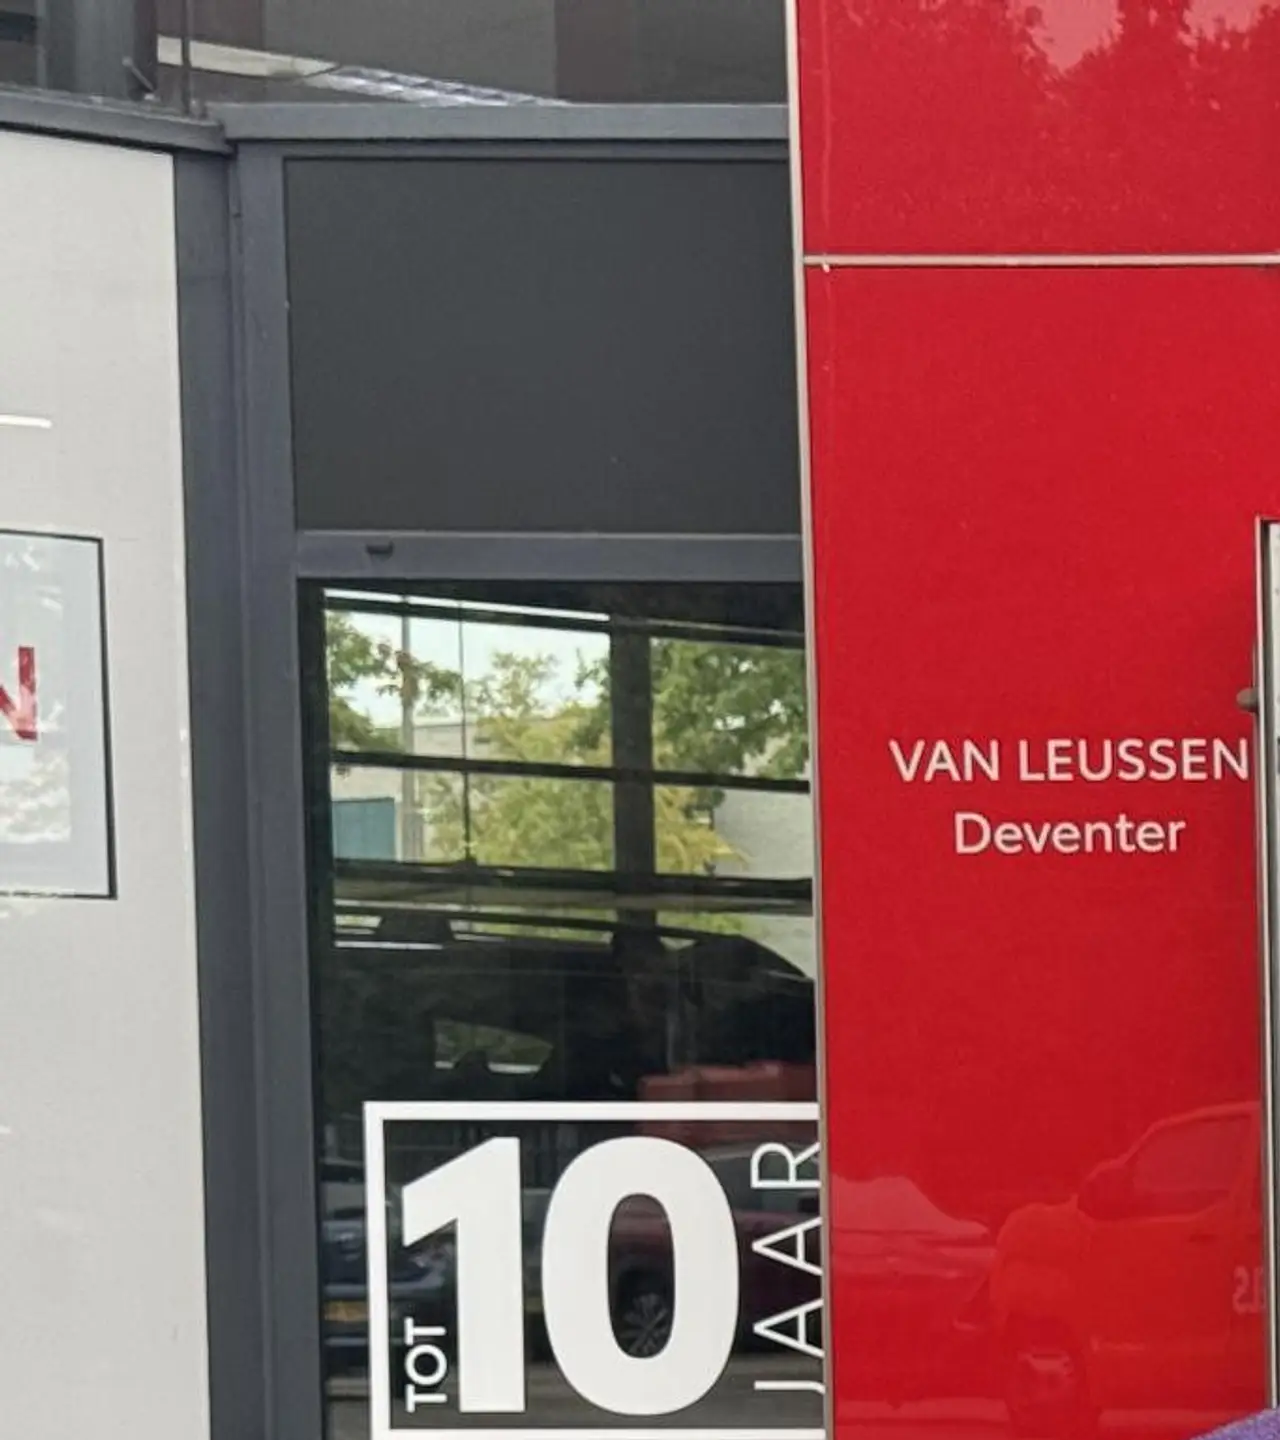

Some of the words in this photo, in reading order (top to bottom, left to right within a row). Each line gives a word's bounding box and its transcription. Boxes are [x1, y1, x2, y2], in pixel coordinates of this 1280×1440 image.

[889, 739, 999, 781] VAN
[1019, 738, 1249, 781] LEUSSEN
[954, 812, 1186, 854] Deventer
[402, 1136, 739, 1415] 10
[750, 1142, 827, 1394] JAAR
[404, 1317, 448, 1413] TOT
